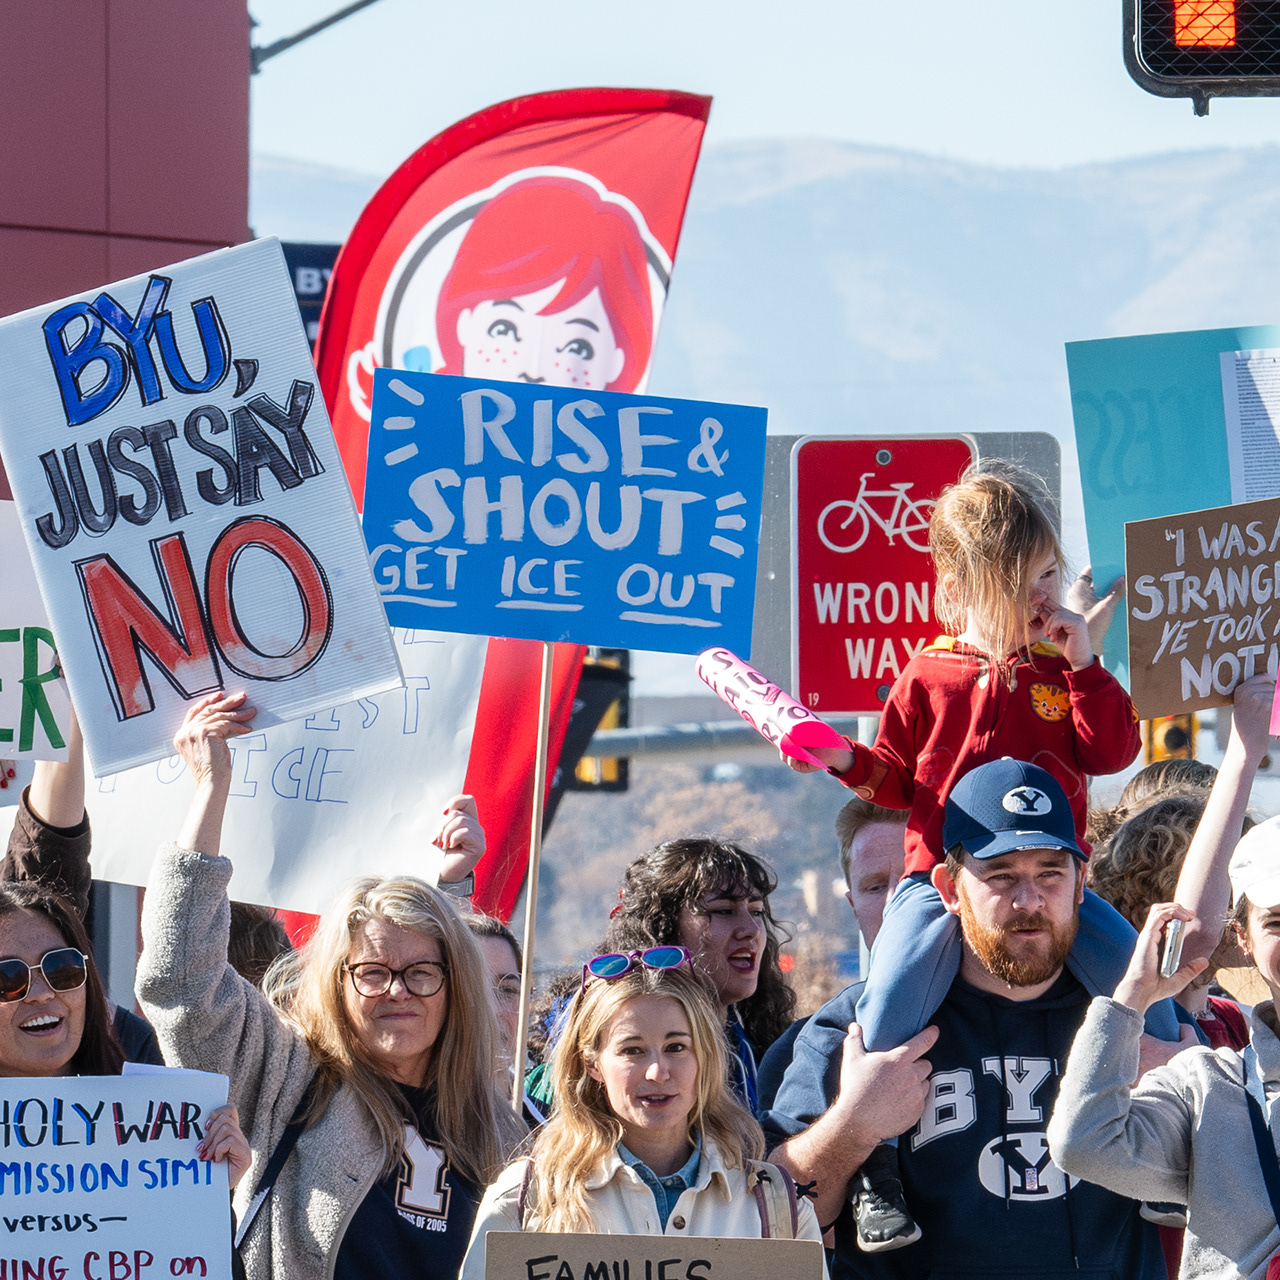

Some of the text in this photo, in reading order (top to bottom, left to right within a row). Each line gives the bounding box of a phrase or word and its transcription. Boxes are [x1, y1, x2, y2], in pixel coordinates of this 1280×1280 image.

[42, 274, 259, 427] BYU,
[460, 388, 731, 478] RISE &
[35, 379, 326, 549] JUST SAY
[392, 467, 708, 557] SHOUT
[1198, 521, 1264, 560] WAS
[370, 545, 735, 612] GET ICE OUT
[813, 582, 929, 625] WRON
[75, 514, 334, 722] NO
[1152, 619, 1199, 665] YE
[1204, 605, 1271, 649] TOOK
[808, 692, 819, 706] 19
[112, 1100, 204, 1146] WAR
[911, 1056, 1058, 1153] BY
[138, 1157, 213, 1189] STMT
[426, 1217, 448, 1233] 2005
[170, 1256, 208, 1277] on
